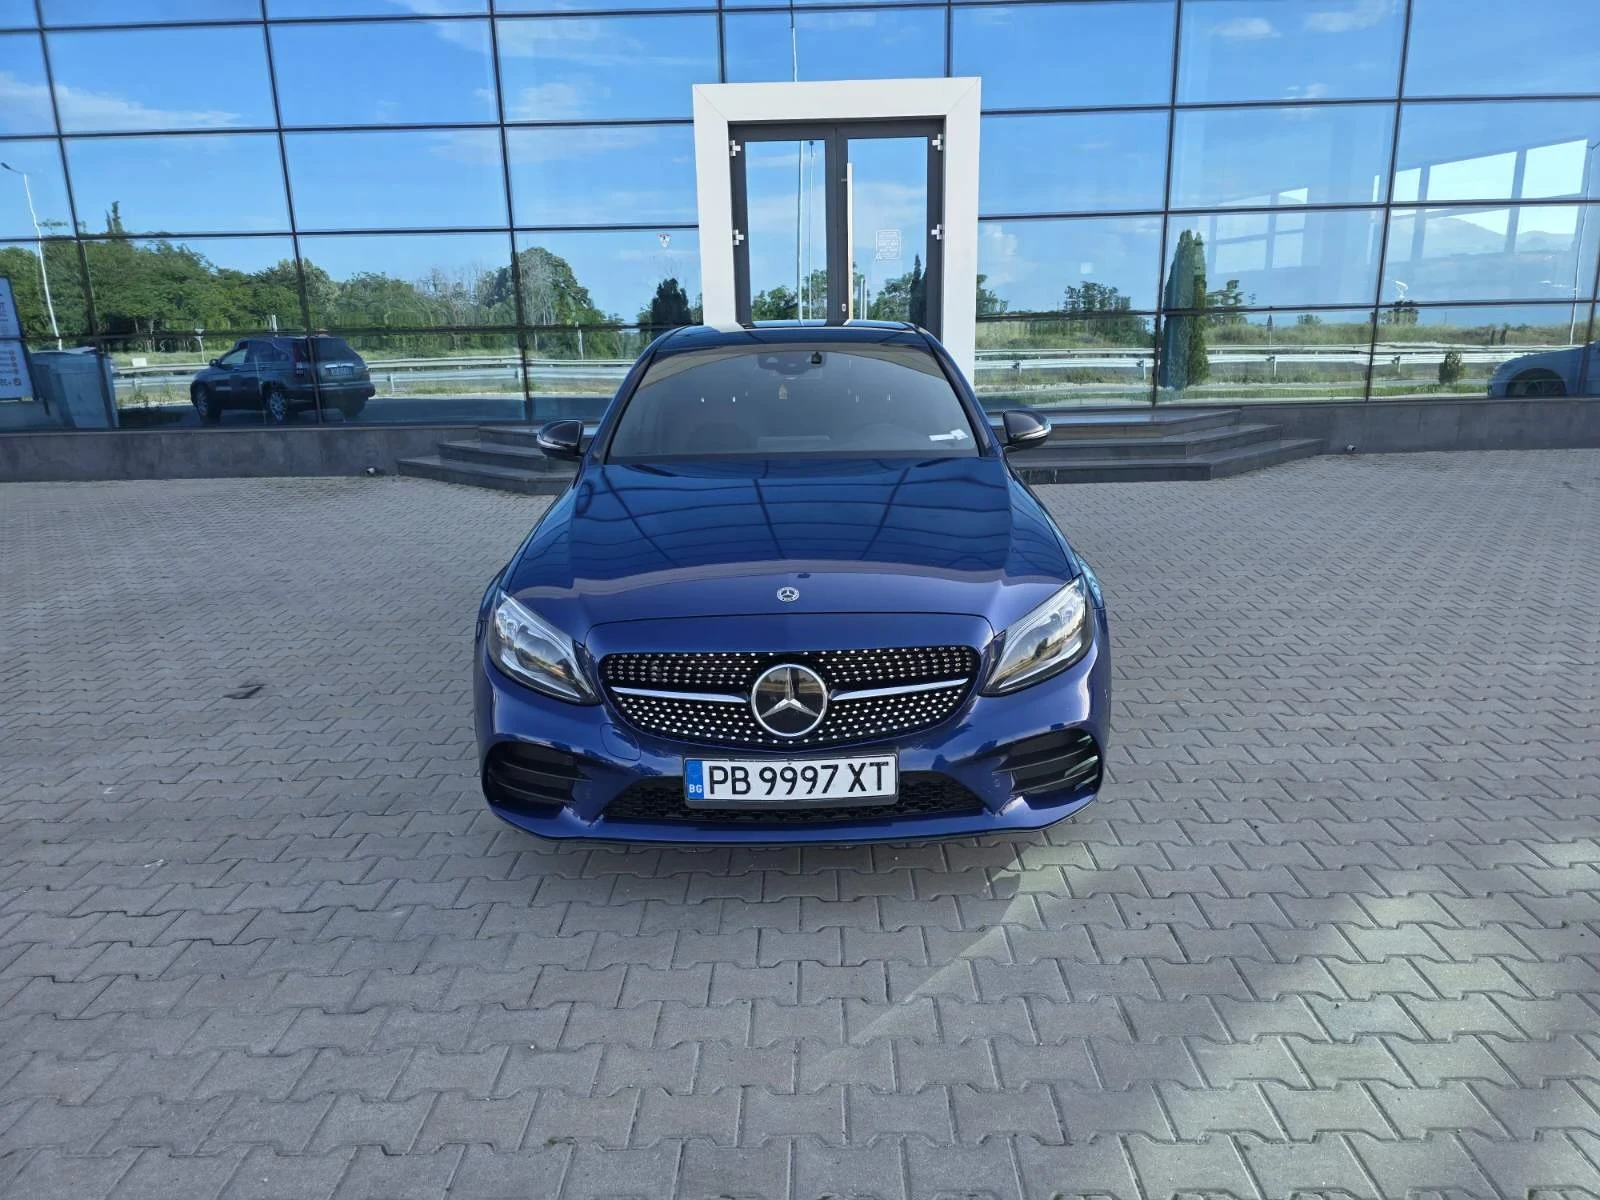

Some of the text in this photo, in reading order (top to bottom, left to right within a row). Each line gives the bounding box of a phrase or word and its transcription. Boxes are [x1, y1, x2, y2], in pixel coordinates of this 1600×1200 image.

[689, 784, 703, 793] BG
[709, 762, 889, 795] PB 9997 XT
